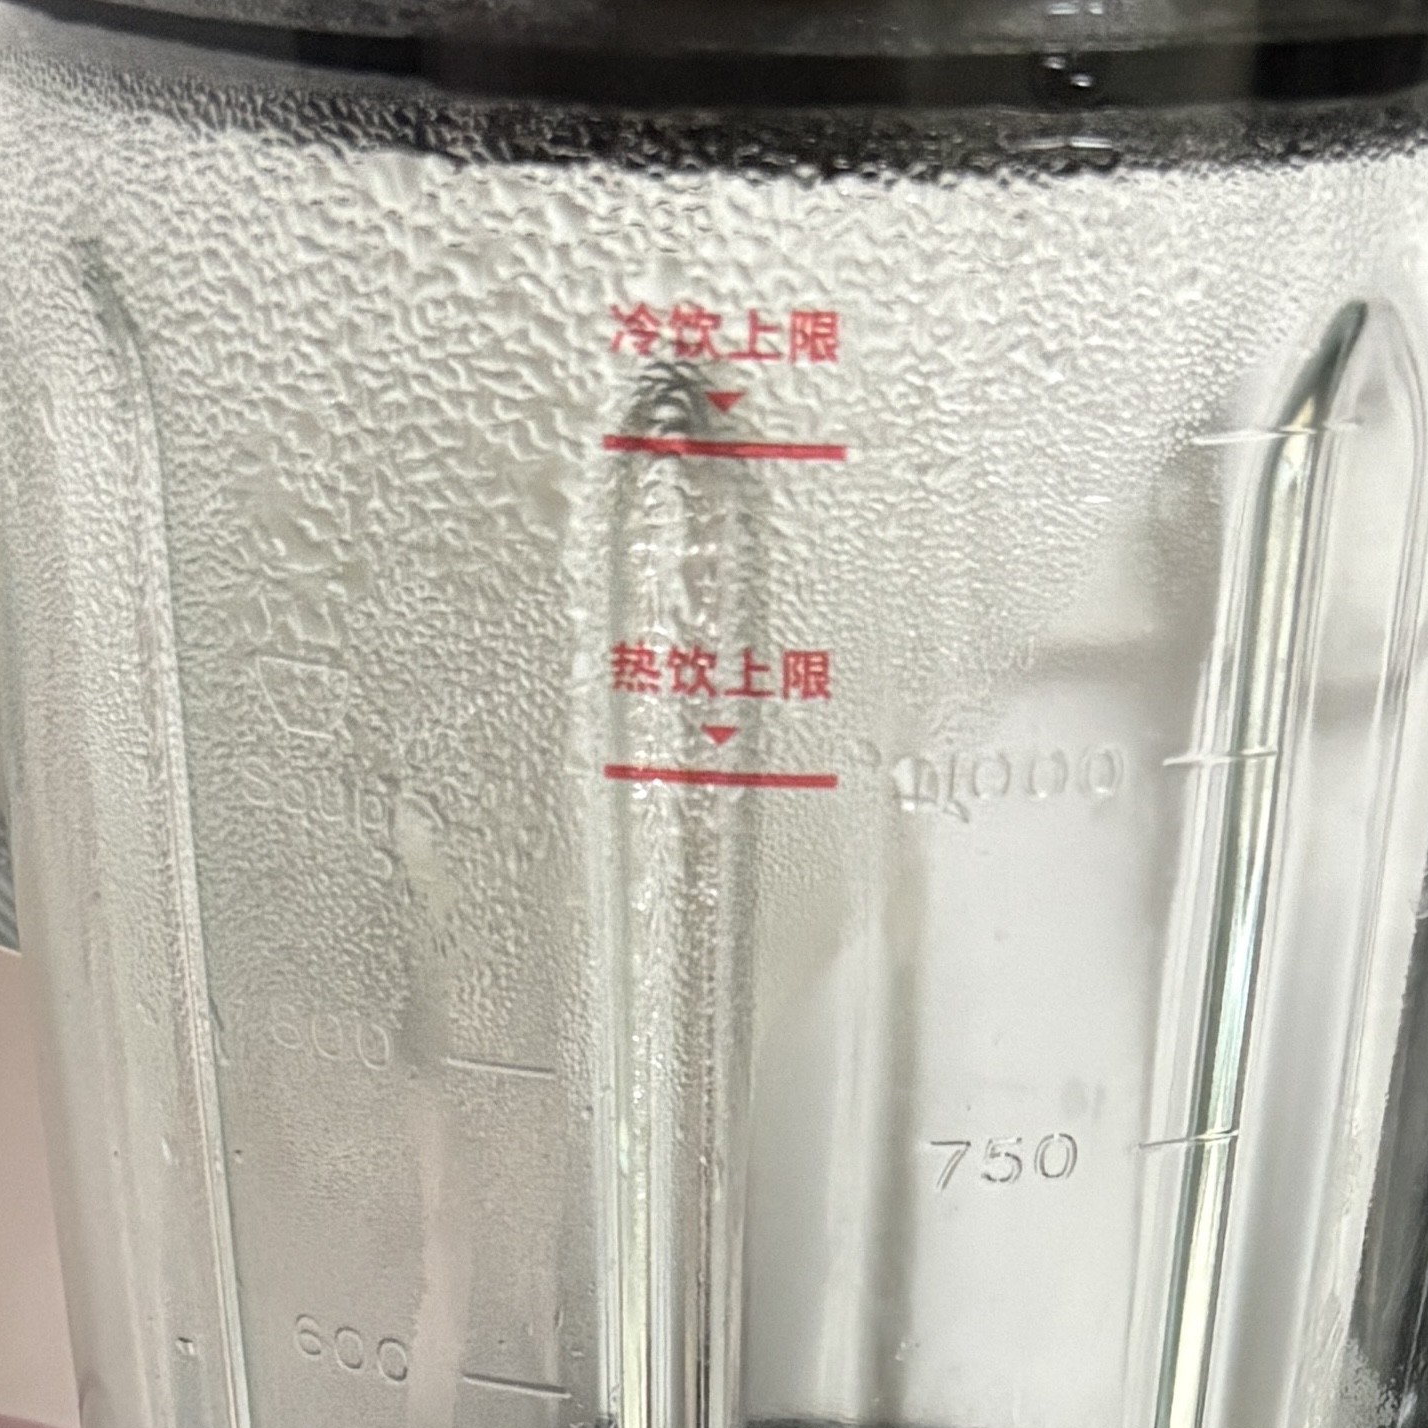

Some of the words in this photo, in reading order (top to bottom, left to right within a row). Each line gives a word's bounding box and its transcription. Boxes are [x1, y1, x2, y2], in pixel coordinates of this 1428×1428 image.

[609, 303, 840, 364] 冷饮上限
[612, 641, 832, 701] 热饮上限
[928, 1131, 1080, 1191] 750
[293, 1312, 409, 1384] 600
